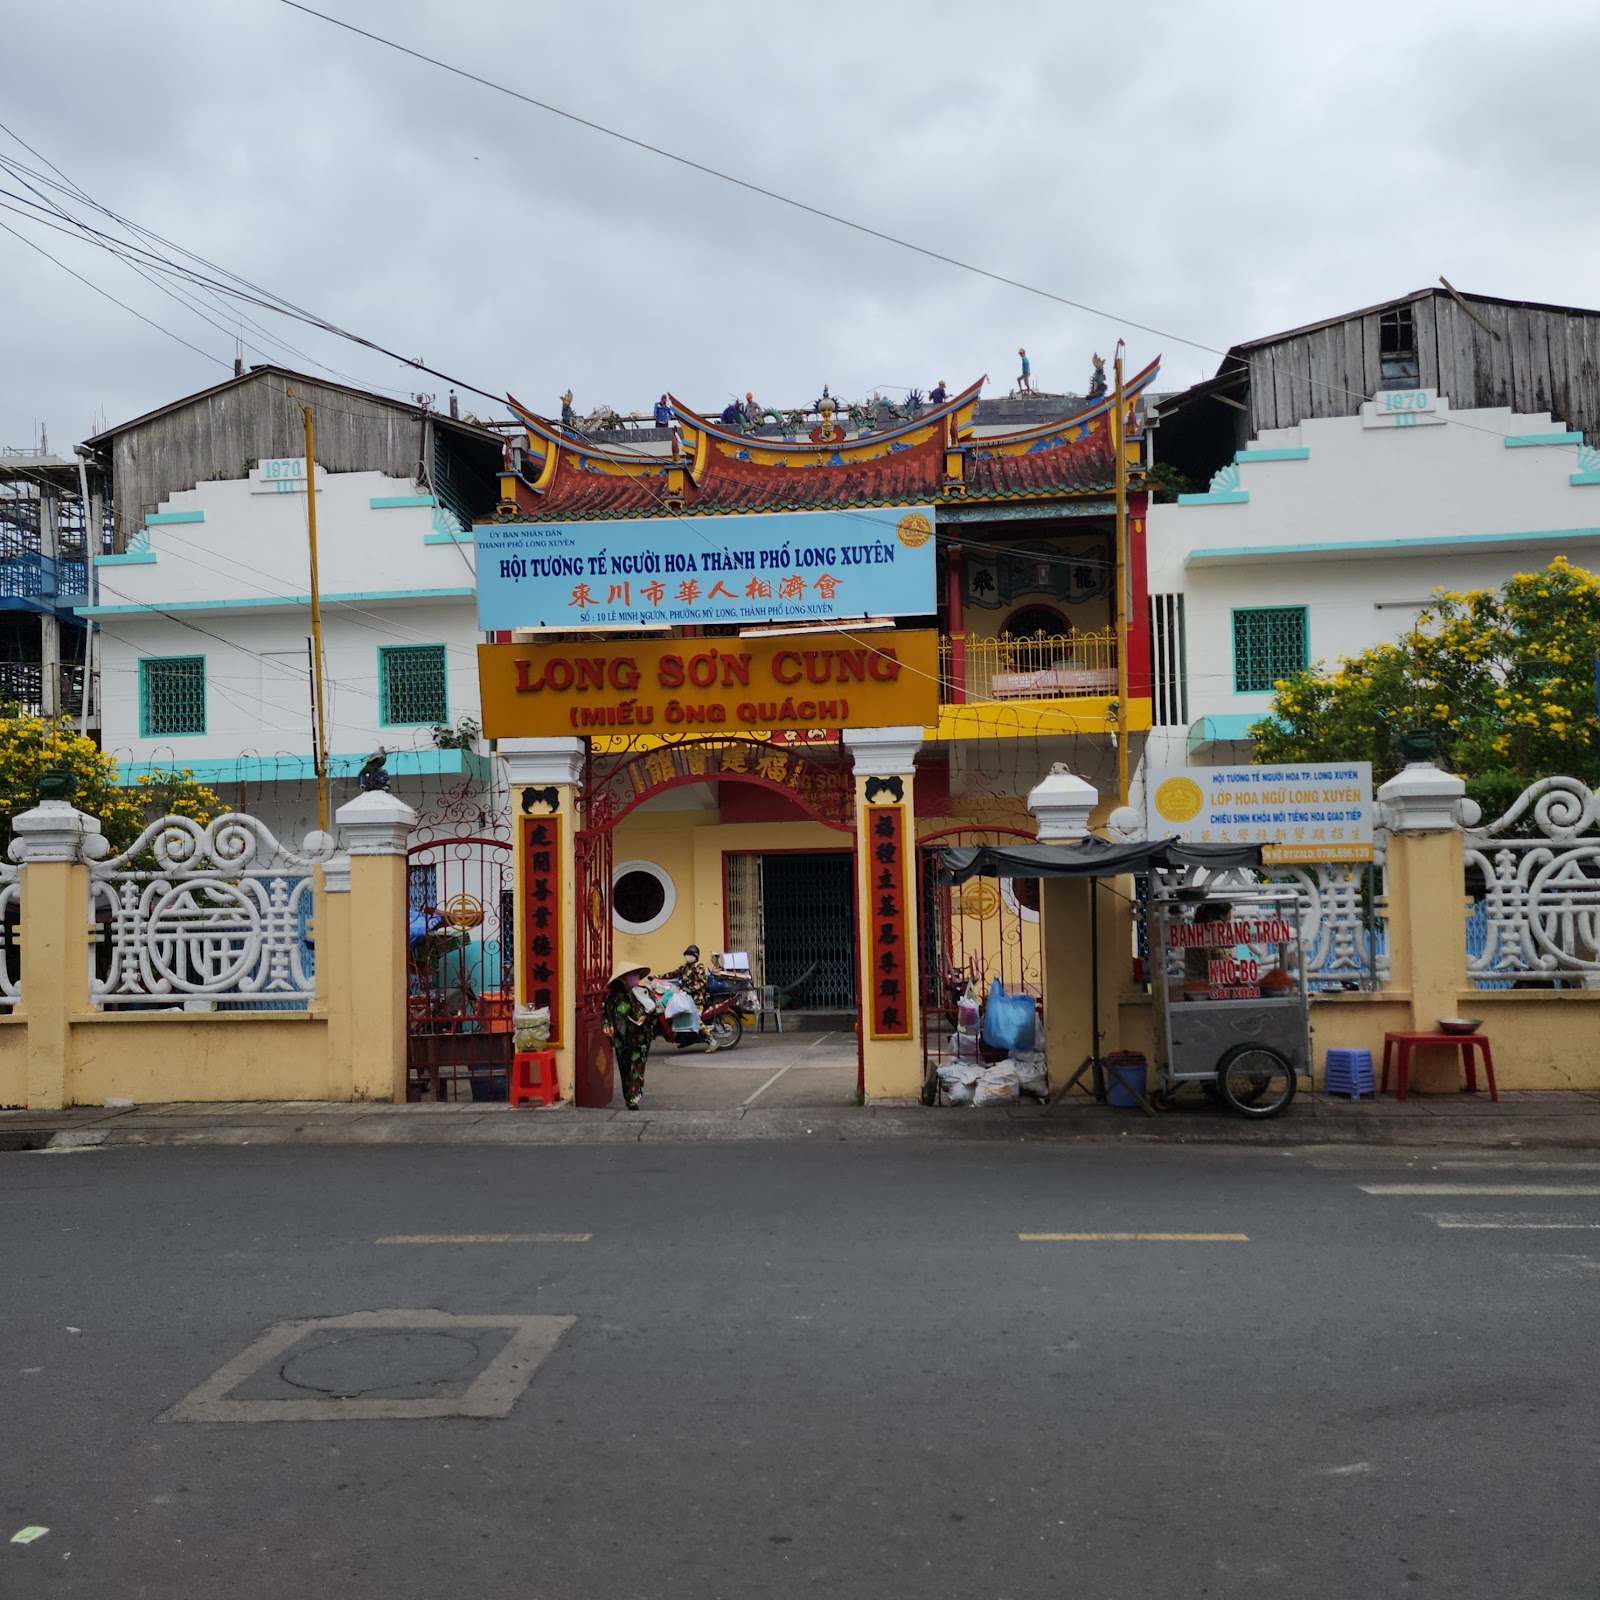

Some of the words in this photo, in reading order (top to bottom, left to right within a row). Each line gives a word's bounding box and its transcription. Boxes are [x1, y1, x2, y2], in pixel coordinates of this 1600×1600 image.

[1385, 391, 1428, 411] 1970
[265, 460, 302, 479] 1970
[478, 540, 506, 549] THÀNH
[507, 537, 524, 548] PHỐ
[548, 538, 576, 547] XUYÊN
[520, 529, 543, 538] NHÂN
[545, 529, 562, 537] DÂN
[500, 554, 527, 583] HỘI
[531, 554, 584, 577] TƯƠNG
[587, 548, 607, 575] TẾ
[611, 549, 661, 575] NGƯỜI
[664, 553, 698, 573] HOA
[701, 546, 756, 571] THÀNH
[759, 540, 791, 569] PHỐ
[795, 547, 837, 567] LONG
[840, 539, 895, 566] XUYÊN
[580, 609, 591, 622] SỐ
[597, 612, 606, 622] 10
[607, 610, 617, 621] LÊ
[618, 612, 639, 621] MINH
[740, 605, 767, 617] THÀNH
[768, 602, 784, 616] PHỐ
[785, 605, 806, 615] LONG
[807, 602, 834, 614] XUYÊN
[514, 655, 642, 693] LONG
[657, 648, 753, 689] SƠN
[771, 646, 903, 686] CUNG
[569, 697, 655, 728] (MIẾU
[664, 699, 727, 724] ÔNG
[736, 696, 849, 723] QUÁCH)
[1212, 771, 1225, 786] HỘI
[1262, 771, 1284, 783] NGƯỜI
[1285, 772, 1300, 781] HOA
[1301, 771, 1312, 781] TP.
[1314, 771, 1333, 780] LONG
[1334, 769, 1358, 780] XUYÊN
[1210, 788, 1232, 806] LỚP
[1235, 792, 1259, 806] HOA
[1289, 790, 1319, 804] LONG
[1322, 785, 1361, 803] XUYÊN
[1233, 813, 1250, 824] SINH
[1287, 808, 1310, 822] TIẾNG
[1311, 811, 1325, 822] HOA
[1327, 811, 1344, 821] GIAO
[1345, 807, 1362, 821] TIẾP
